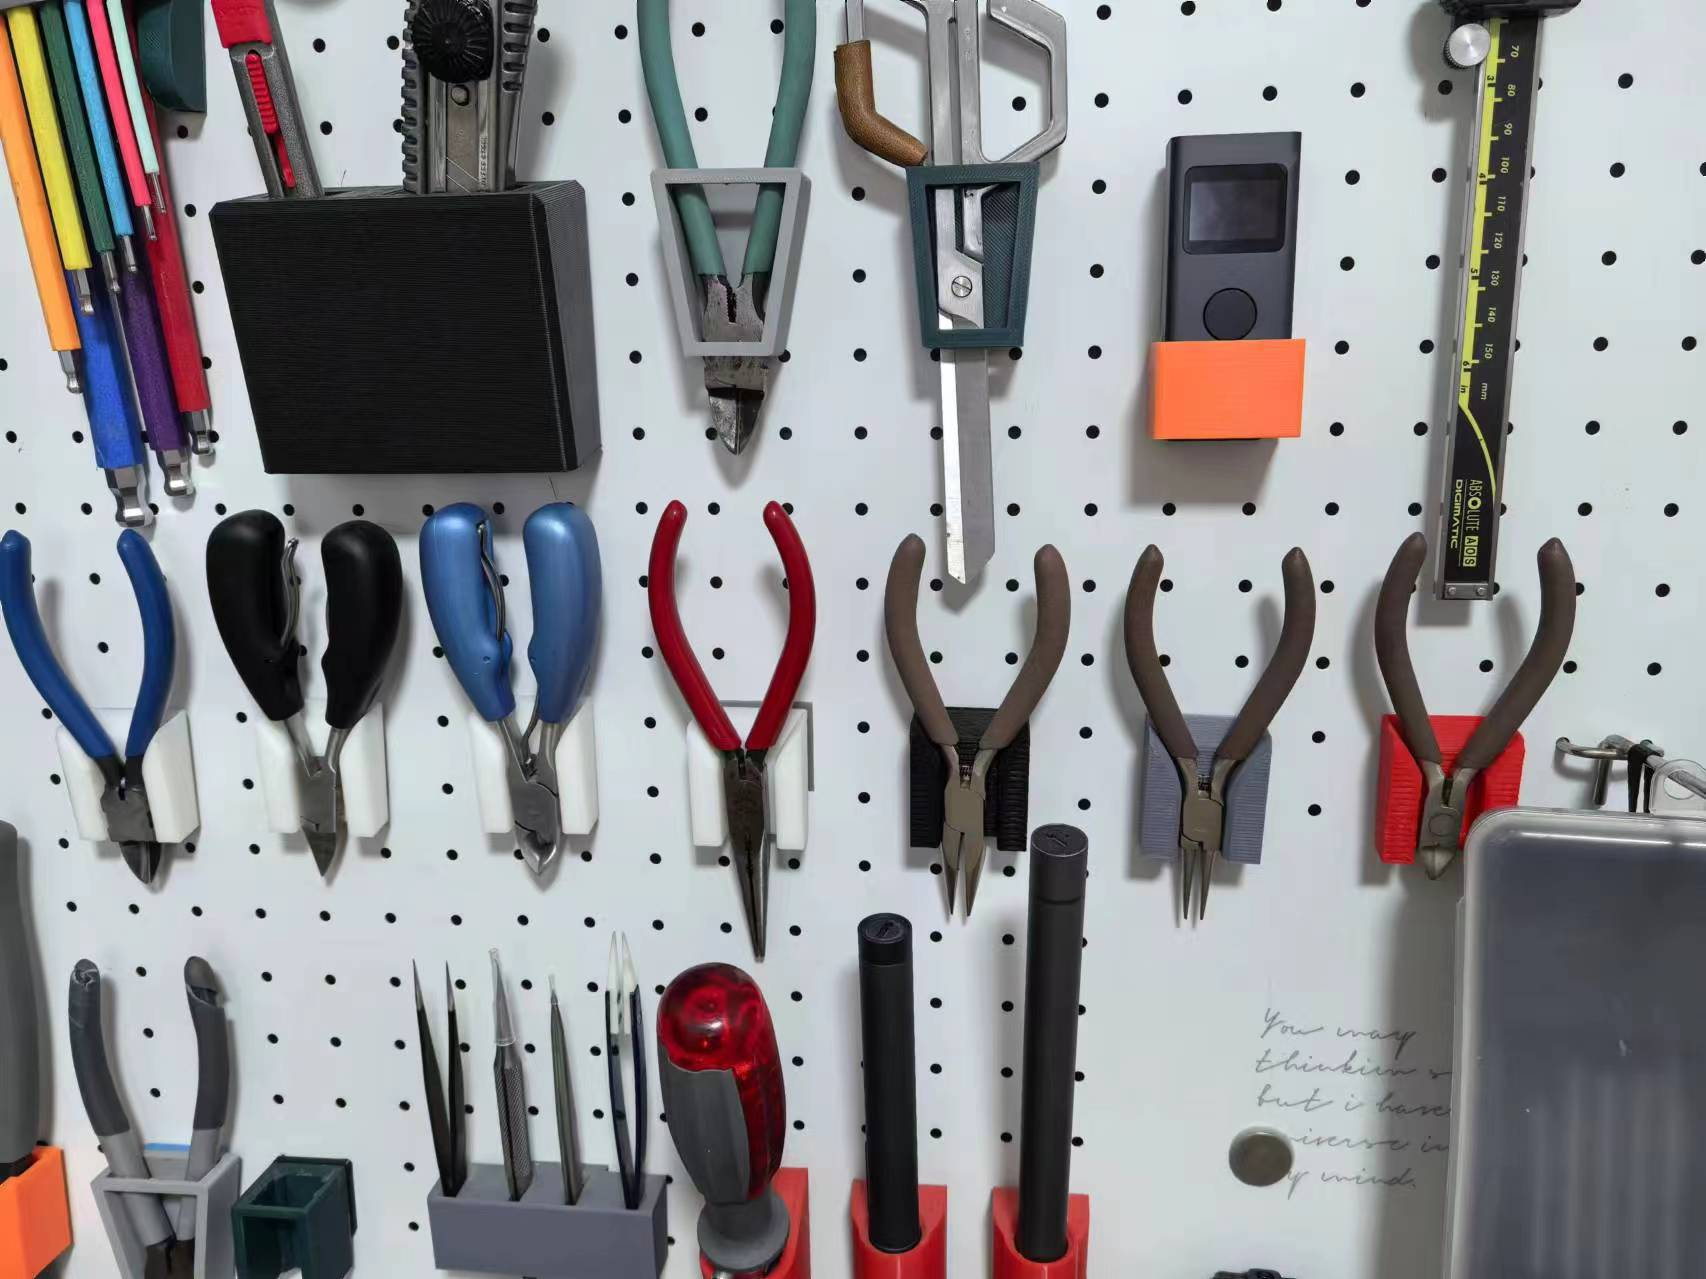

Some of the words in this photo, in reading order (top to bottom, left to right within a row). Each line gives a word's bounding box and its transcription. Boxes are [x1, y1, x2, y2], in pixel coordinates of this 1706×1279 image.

[1510, 45, 1520, 58] 70
[1507, 83, 1516, 97] 80
[1503, 122, 1513, 136] 90
[1500, 156, 1510, 174] 100
[1497, 196, 1506, 212] 110
[1494, 232, 1503, 249] 120
[1490, 270, 1500, 287] 130
[1487, 306, 1497, 323] 140
[1484, 343, 1493, 359] 150
[1459, 385, 1467, 394] in
[1481, 382, 1488, 400] mm
[1467, 479, 1483, 531] ABSOLUTE
[1450, 479, 1463, 549] DIGIMATIC
[1463, 536, 1478, 567] AOS
[1261, 1008, 1324, 1039] You
[1336, 1027, 1416, 1060] may
[1257, 1084, 1334, 1112] but
[1290, 1128, 1409, 1151] iverse
[1286, 1169, 1310, 1200] y
